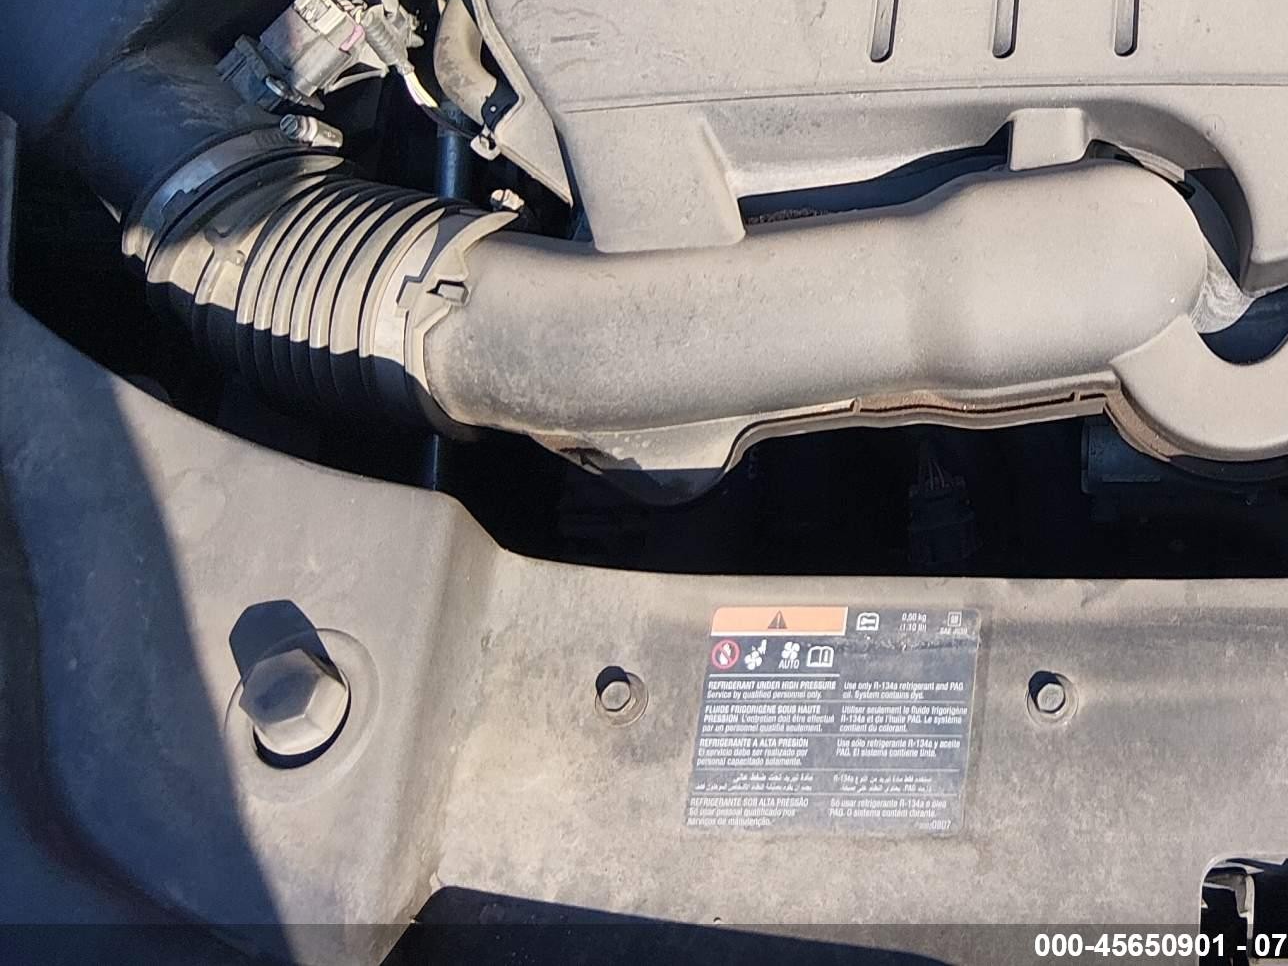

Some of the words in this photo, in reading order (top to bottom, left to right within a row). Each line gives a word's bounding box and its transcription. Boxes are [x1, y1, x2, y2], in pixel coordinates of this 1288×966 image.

[778, 658, 800, 670] AUTO
[708, 681, 755, 690] REFRIGERANT
[756, 681, 780, 690] UNDER
[781, 681, 798, 690] HIGH
[800, 681, 836, 690] PRESSURE
[936, 682, 948, 690] and
[707, 690, 731, 699] Service
[773, 690, 806, 699] personnel
[807, 690, 822, 699] only.
[798, 705, 821, 714] HAUTE
[704, 714, 738, 723] PRESSION
[702, 724, 713, 732] par
[725, 724, 758, 732] personnel
[700, 738, 751, 747] REFRIGERANTE
[752, 738, 758, 747] A
[759, 738, 777, 747] ALTA
[697, 757, 726, 766] personal
[759, 797, 775, 808] ALTA
